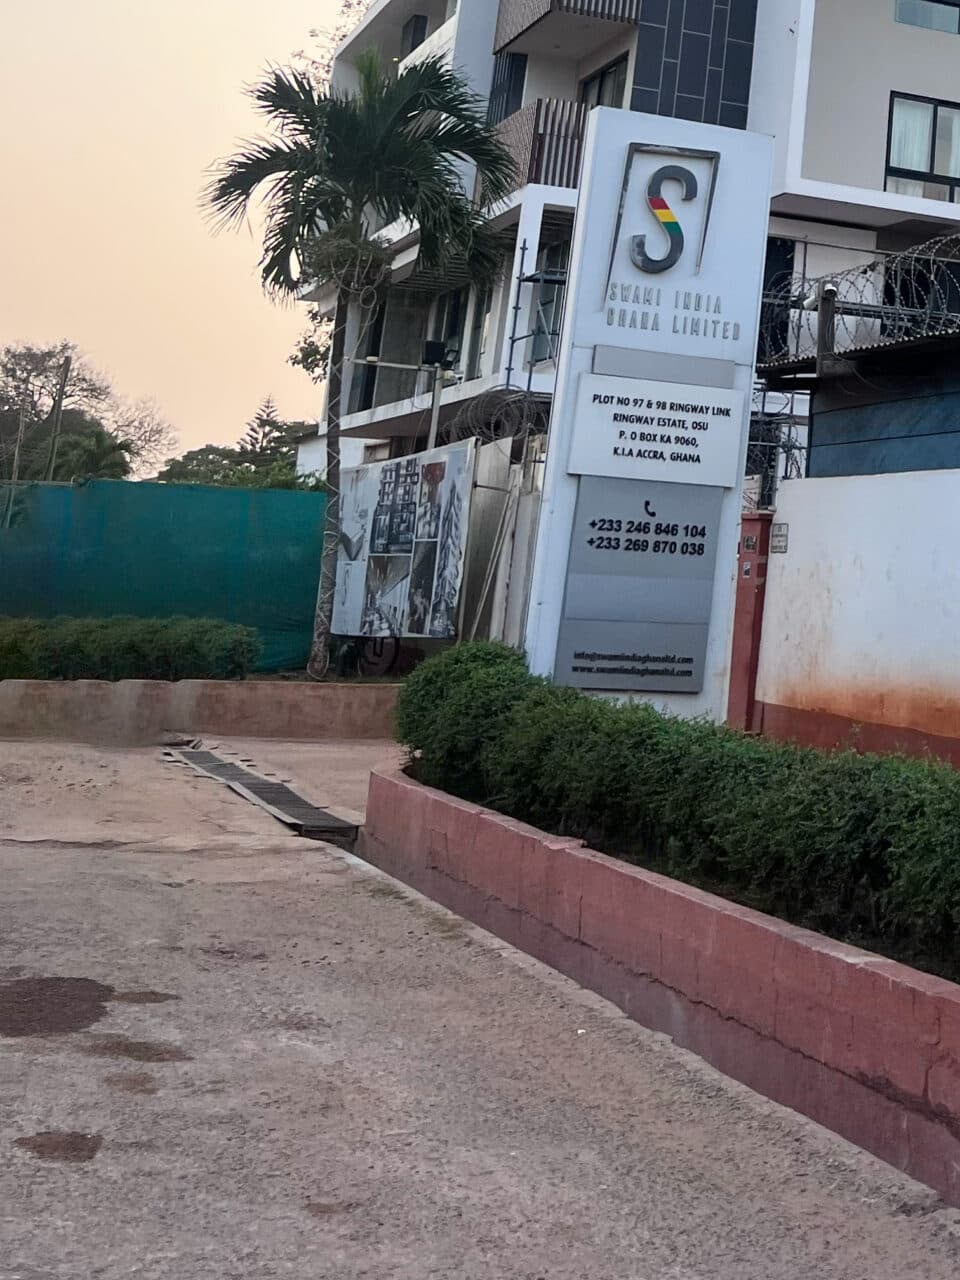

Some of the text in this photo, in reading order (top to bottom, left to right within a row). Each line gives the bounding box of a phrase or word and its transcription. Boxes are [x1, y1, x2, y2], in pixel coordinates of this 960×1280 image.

[609, 282, 722, 314] SWAMI INDIA
[606, 307, 741, 341] GHANA LIMITED
[592, 394, 732, 417] PLOT NO 97 & 98 RINGWAY LINK
[612, 413, 709, 431] RINGWAY ESTATE, OSU
[640, 432, 658, 442] BOX
[660, 434, 672, 444] KA
[674, 436, 699, 448] 9060,
[635, 449, 667, 461] ACCRA,
[670, 452, 701, 463] GHANA
[589, 519, 706, 538] +233 246 846 104
[587, 536, 705, 556] +233 269 870 038
